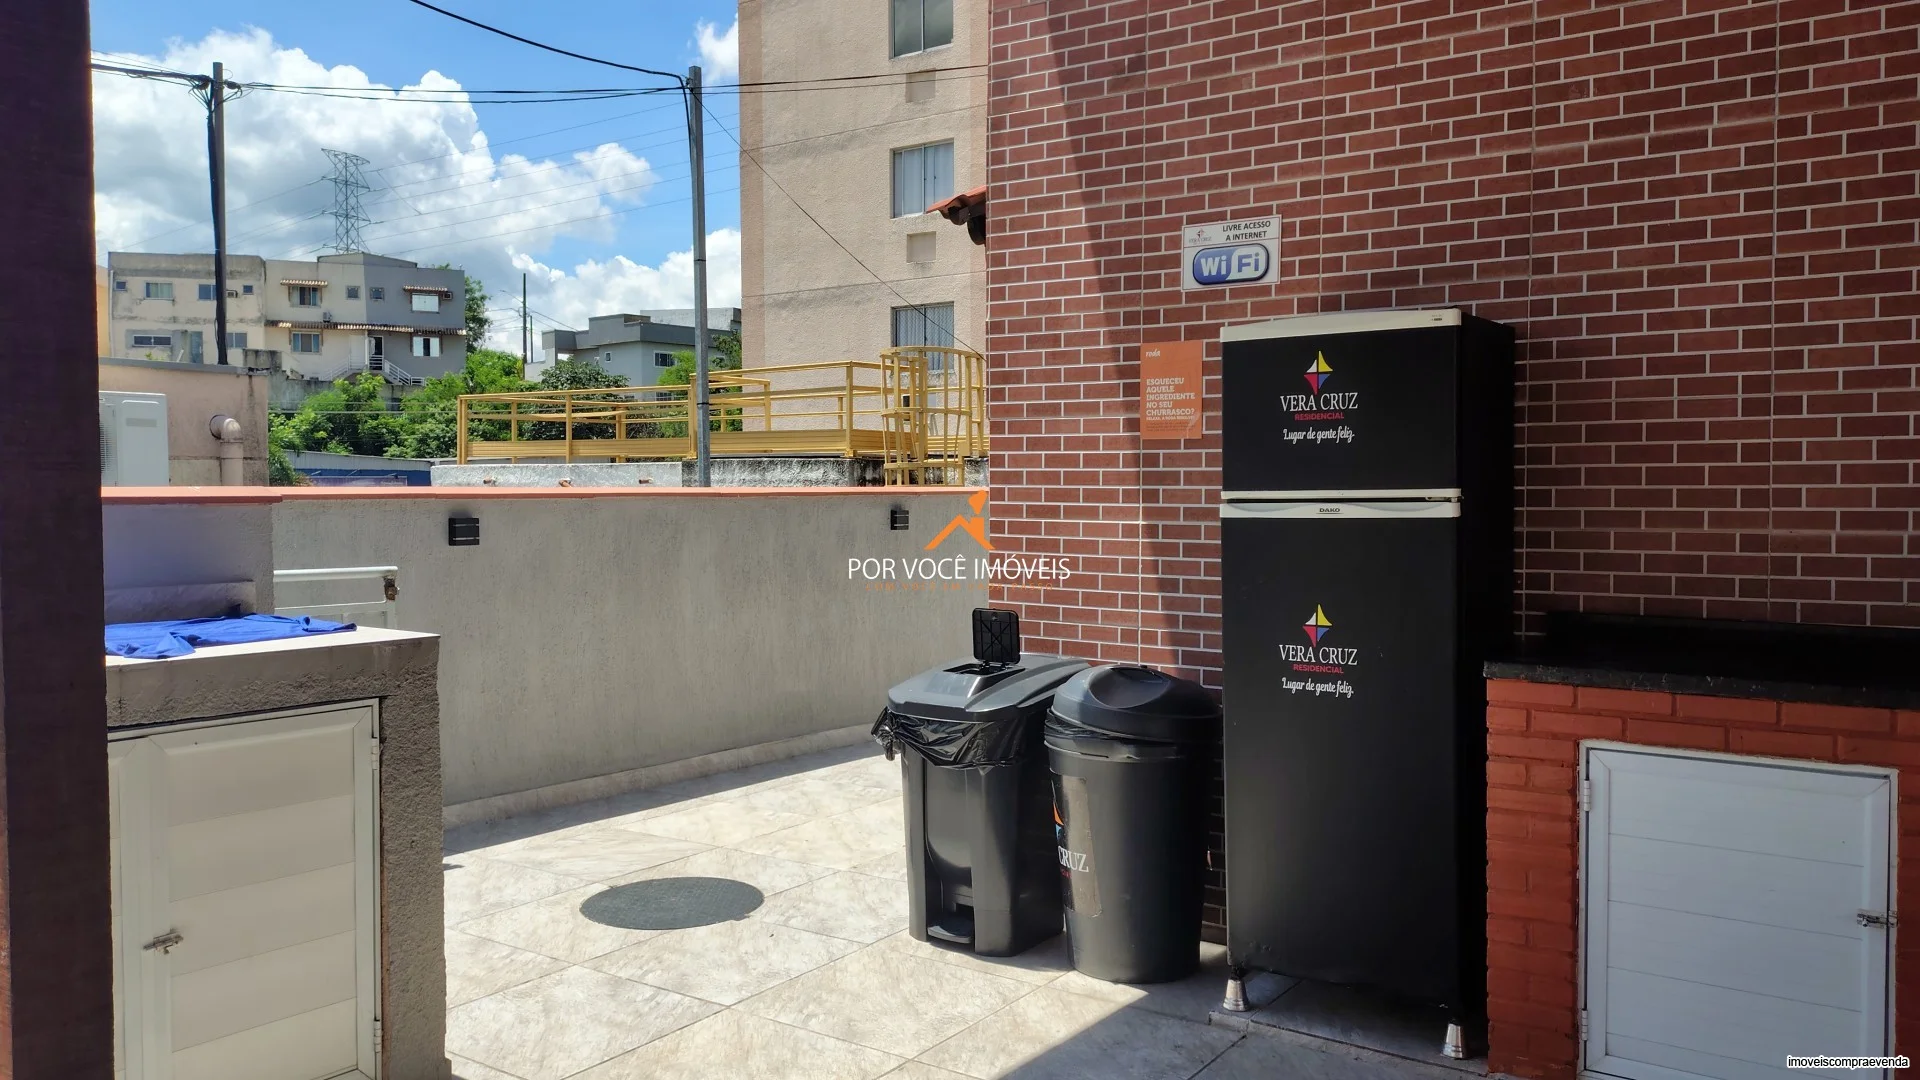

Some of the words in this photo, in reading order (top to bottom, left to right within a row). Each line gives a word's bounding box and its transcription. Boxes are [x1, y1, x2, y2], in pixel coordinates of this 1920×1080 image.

[1222, 223, 1242, 232] LIVRE
[1243, 220, 1271, 230] ACESSO
[1225, 234, 1231, 242] A
[1232, 230, 1268, 241] INTERNET
[1146, 377, 1185, 386] ESQUECEU
[1146, 385, 1175, 393] AQUELE
[1146, 392, 1196, 401] INGREDIENTE
[1280, 394, 1317, 412] VERA
[1320, 392, 1358, 411] CRUZ
[1146, 401, 1158, 409] NO
[1146, 408, 1195, 416] CHURRASCO?
[1294, 411, 1345, 421] RESIDENCIAL
[1282, 428, 1306, 445] Lugar
[1306, 426, 1316, 440] de
[1316, 428, 1337, 444] gente
[1279, 644, 1316, 663] VERA
[1319, 646, 1358, 665] CRUZ
[1292, 663, 1344, 674] RESIDENCIAL
[1281, 676, 1305, 694] Lugar
[1305, 677, 1316, 691] de
[1315, 681, 1336, 697] gente
